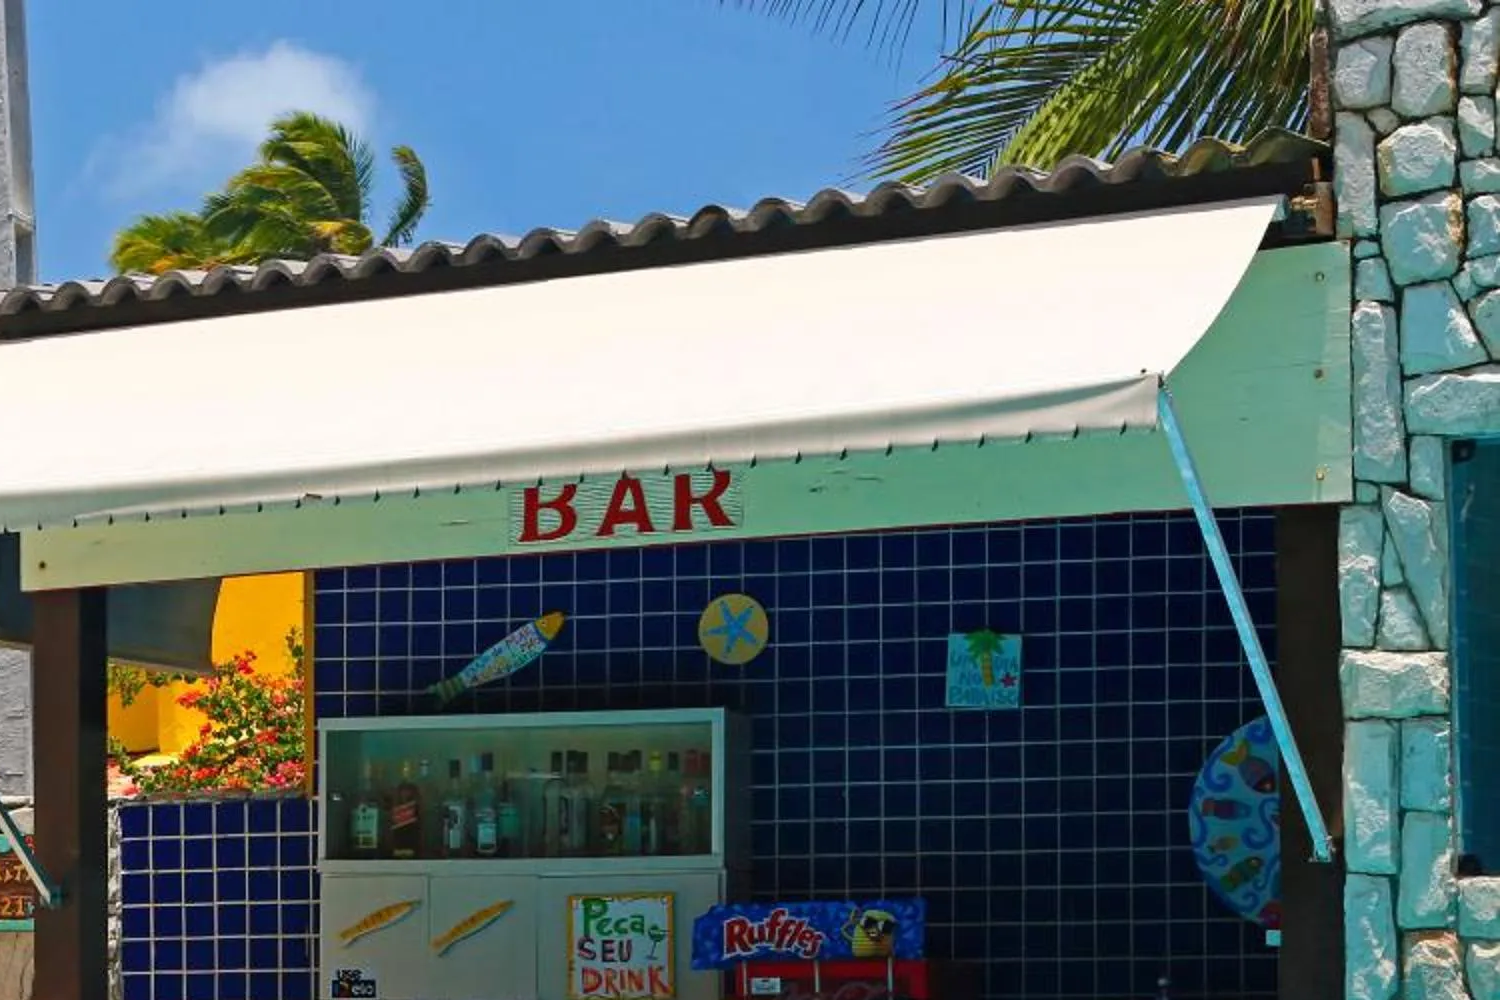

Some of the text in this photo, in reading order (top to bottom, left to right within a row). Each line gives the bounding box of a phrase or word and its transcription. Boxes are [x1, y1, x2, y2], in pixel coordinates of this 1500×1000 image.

[519, 470, 736, 542] BAR
[0, 896, 26, 918] 21
[723, 907, 825, 958] Ruffles
[577, 938, 633, 962] SEU
[581, 964, 671, 995] DRINK
